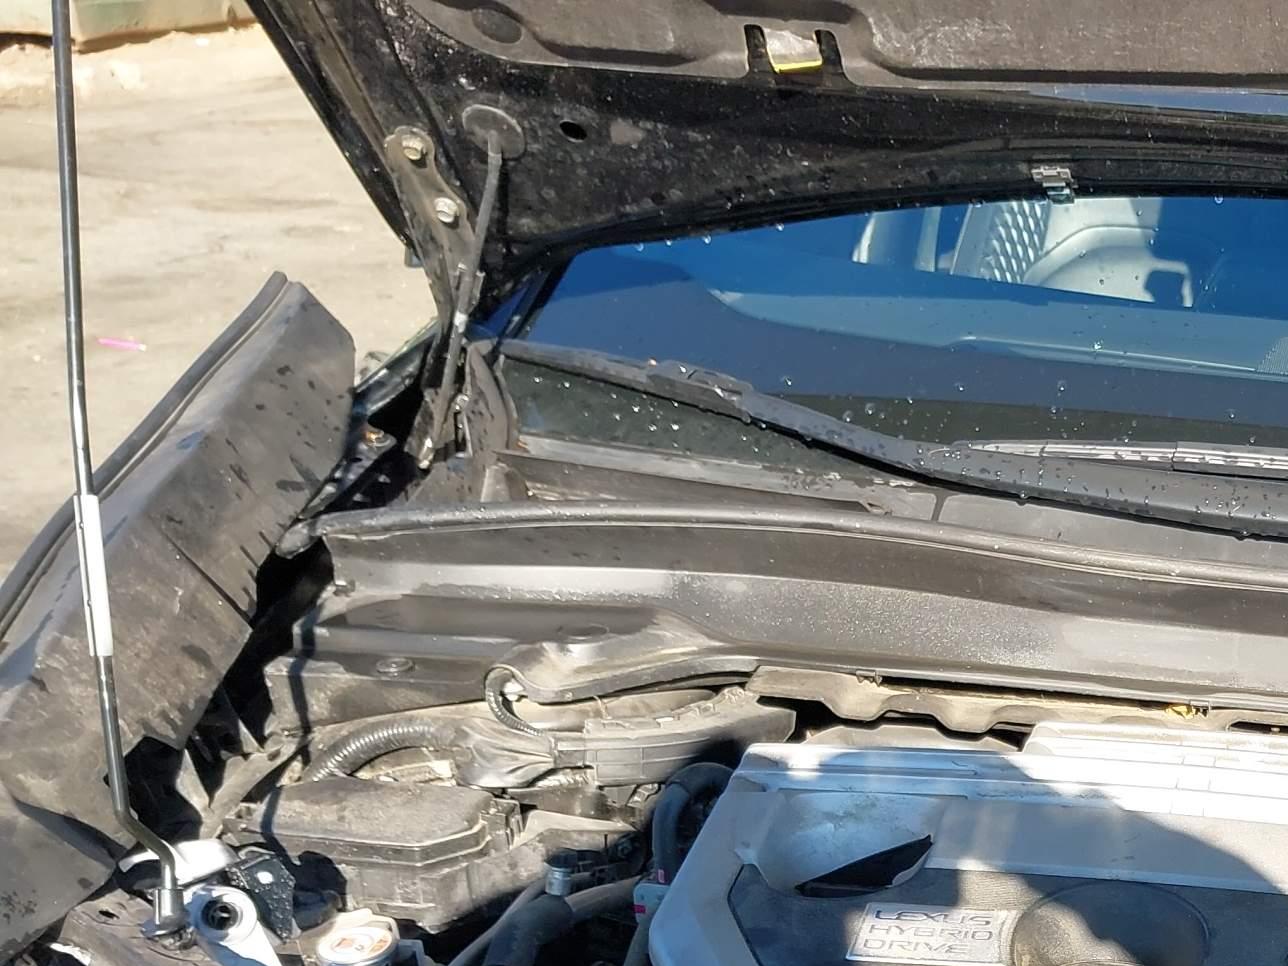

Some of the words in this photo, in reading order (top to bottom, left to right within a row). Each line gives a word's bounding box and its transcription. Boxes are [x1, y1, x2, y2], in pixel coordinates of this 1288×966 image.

[875, 909, 994, 926] LEXUS
[868, 924, 994, 941] HYBRID
[863, 938, 969, 954] DRIVE
